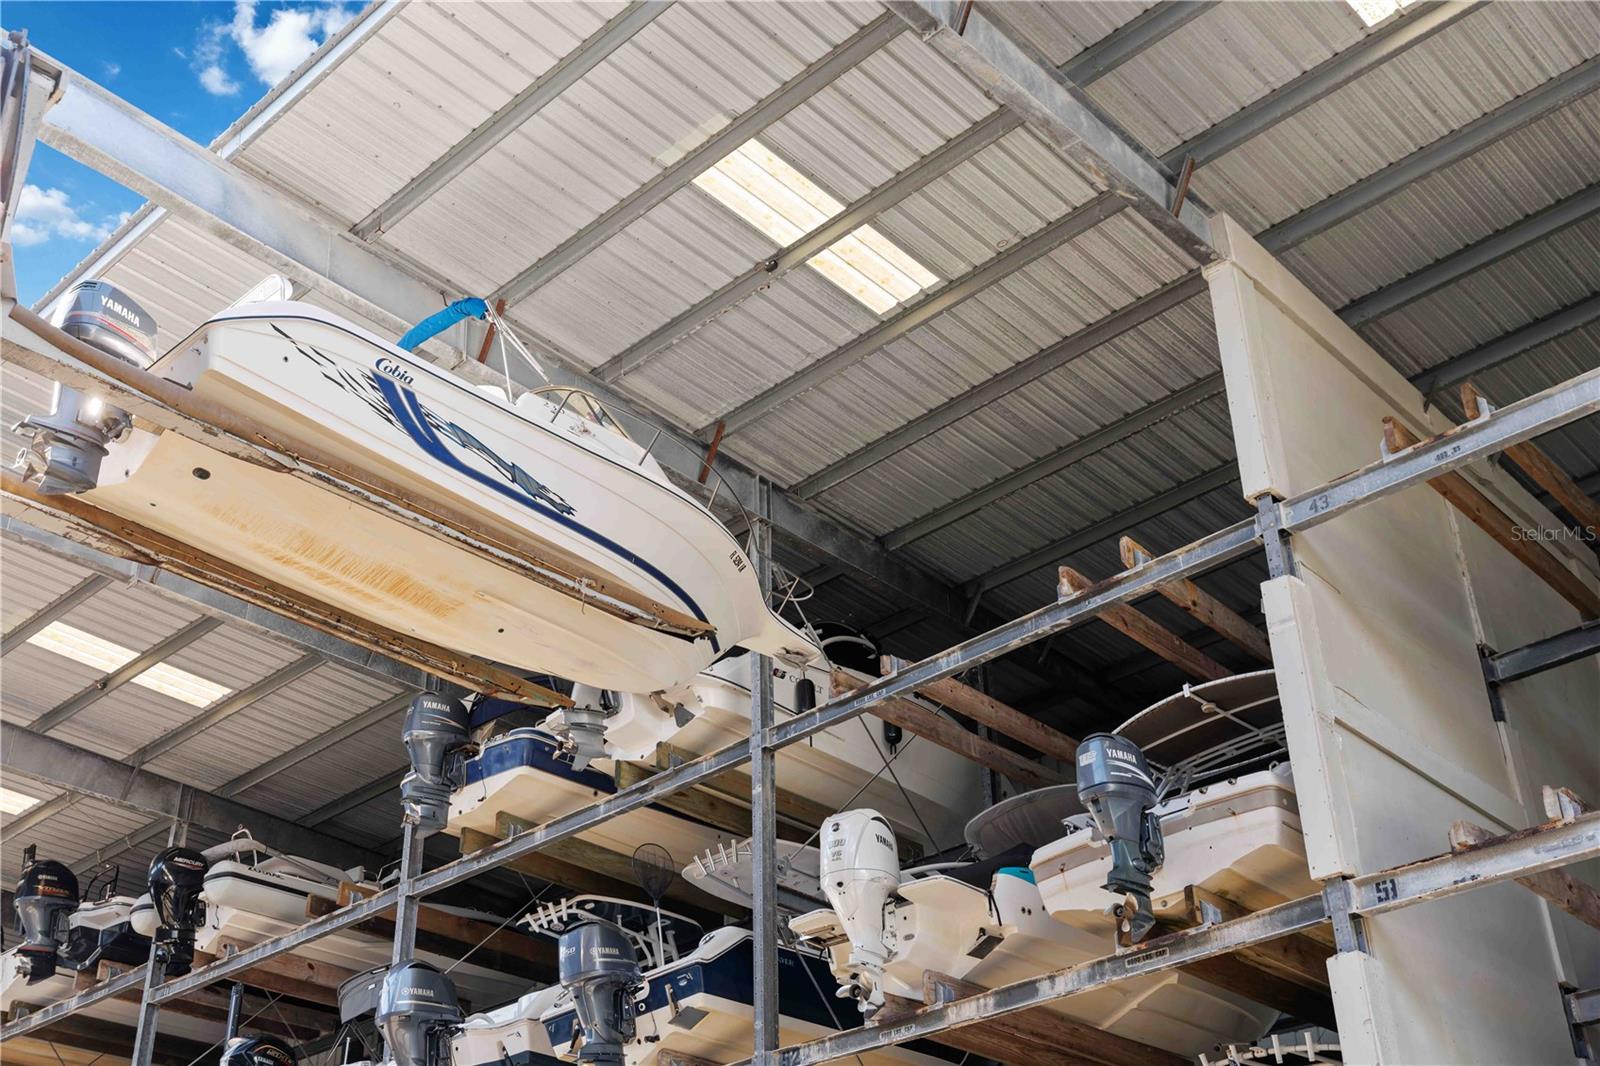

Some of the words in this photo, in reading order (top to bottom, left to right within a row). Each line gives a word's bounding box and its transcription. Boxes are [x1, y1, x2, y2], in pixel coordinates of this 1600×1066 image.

[101, 295, 140, 327] YAMAHA
[375, 357, 414, 384] Cobia
[1309, 494, 1329, 513] 43
[423, 700, 451, 713] YAMAHA
[1106, 748, 1137, 765] YAMAHA
[1375, 878, 1398, 903] 51
[410, 987, 434, 998] YAMAHA
